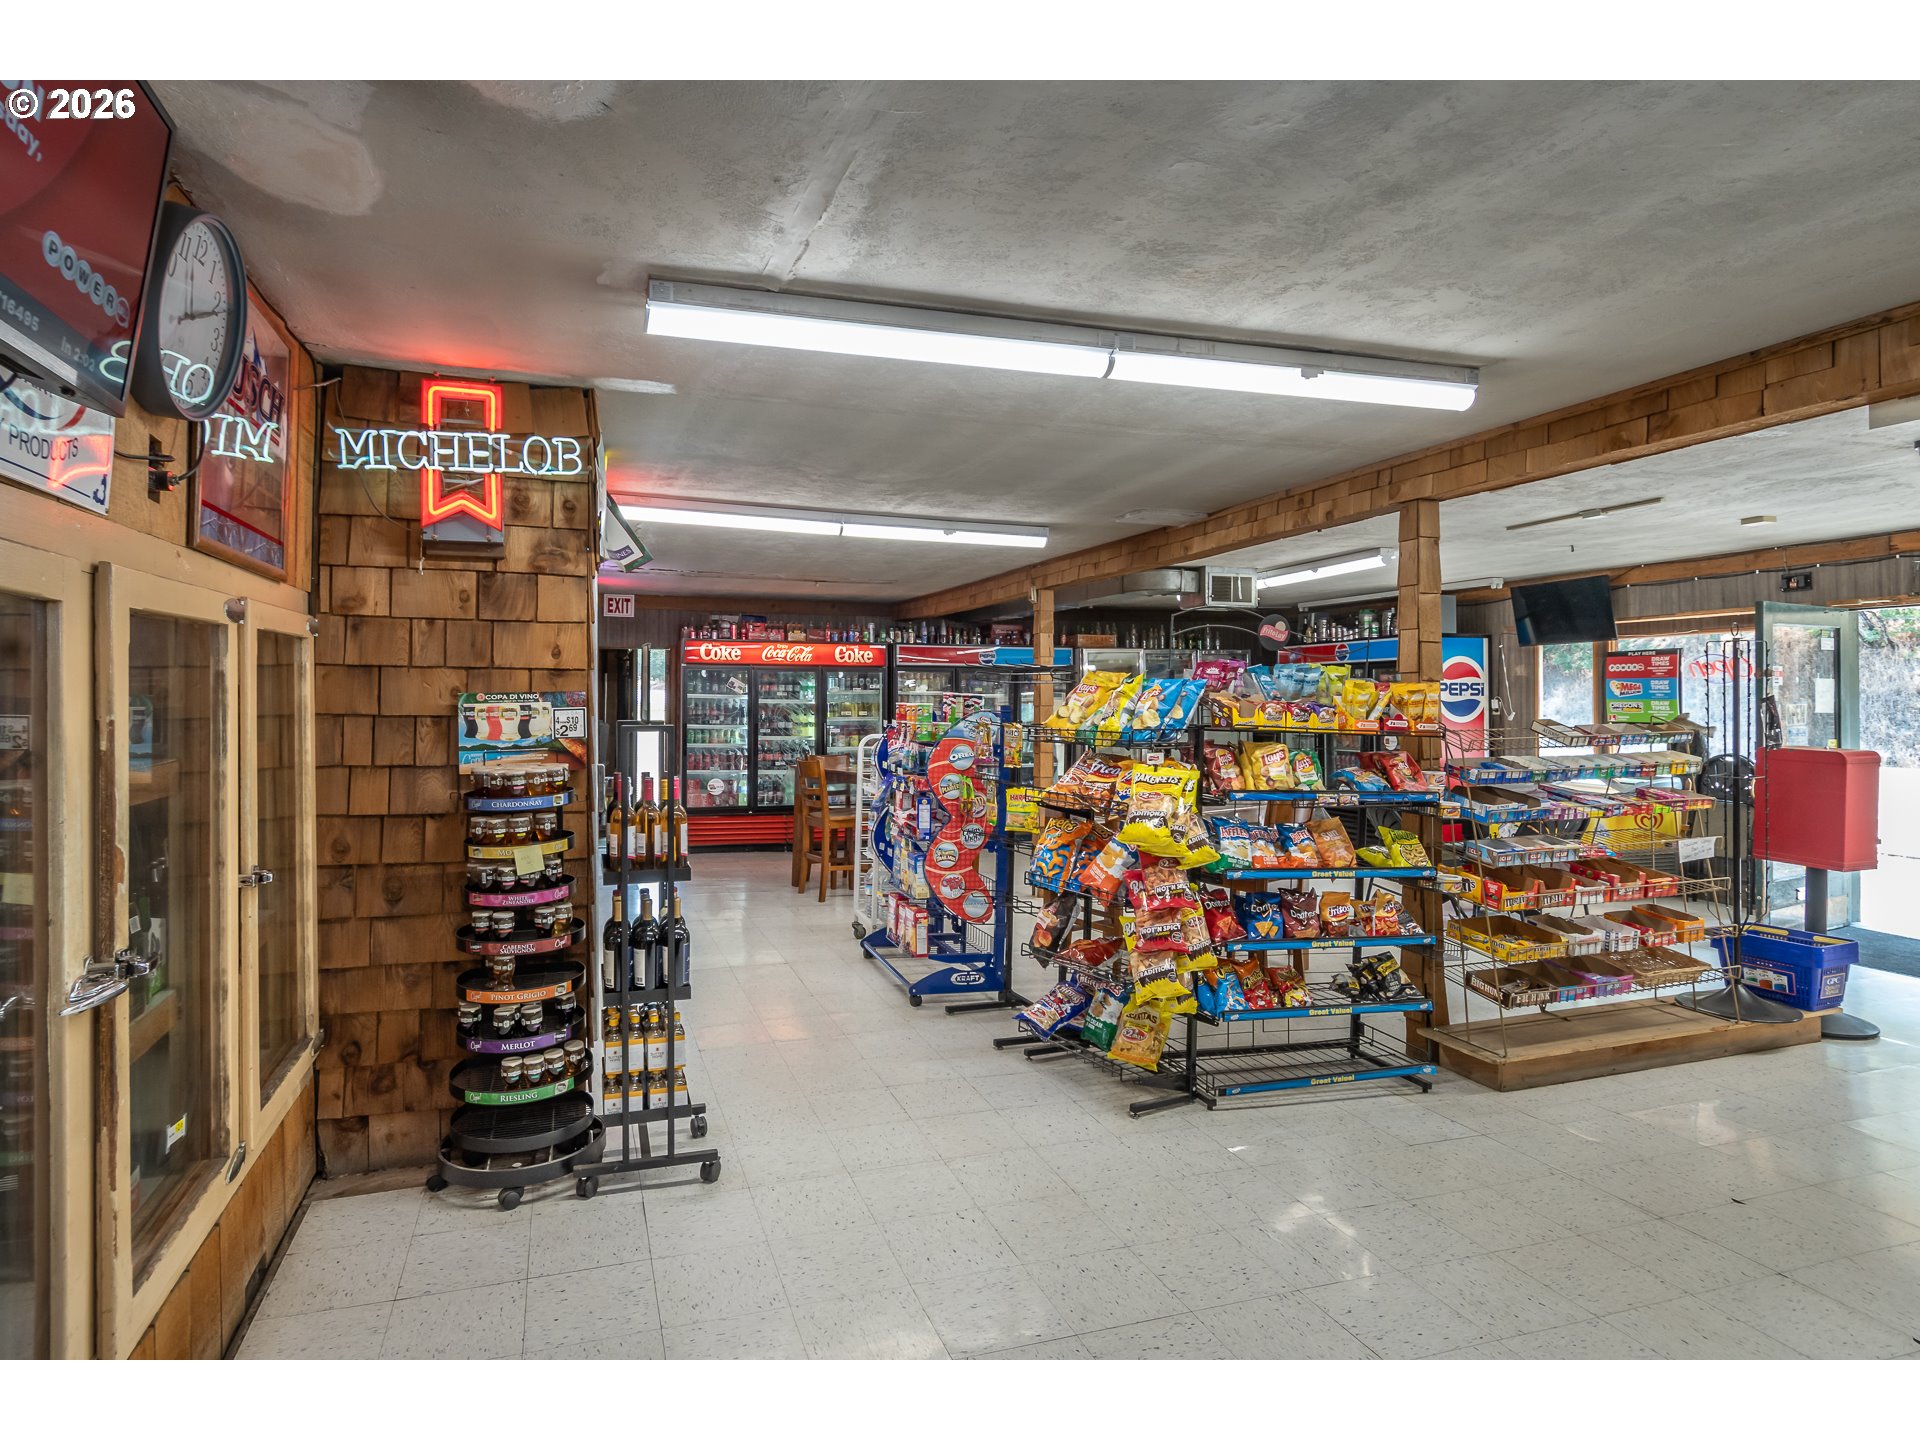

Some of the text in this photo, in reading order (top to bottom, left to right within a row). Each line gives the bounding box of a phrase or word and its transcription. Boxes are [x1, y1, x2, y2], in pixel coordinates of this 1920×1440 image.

[8, 423, 79, 461] PRODUCTS
[335, 429, 583, 476] MICHELOB
[607, 597, 631, 614] EXIT
[700, 642, 741, 661] Coke
[834, 644, 874, 663] Coke
[1440, 682, 1485, 697] PEPSI
[491, 800, 543, 808] CHARDONNAY
[1312, 870, 1355, 878] Great Value!
[957, 974, 980, 982] KRAFT
[491, 993, 514, 1001] PINOT
[516, 991, 547, 999] GRIGIO
[1331, 1007, 1352, 1015] Value!
[501, 1041, 536, 1051] MERLOT
[500, 1092, 538, 1102] RIESLING
